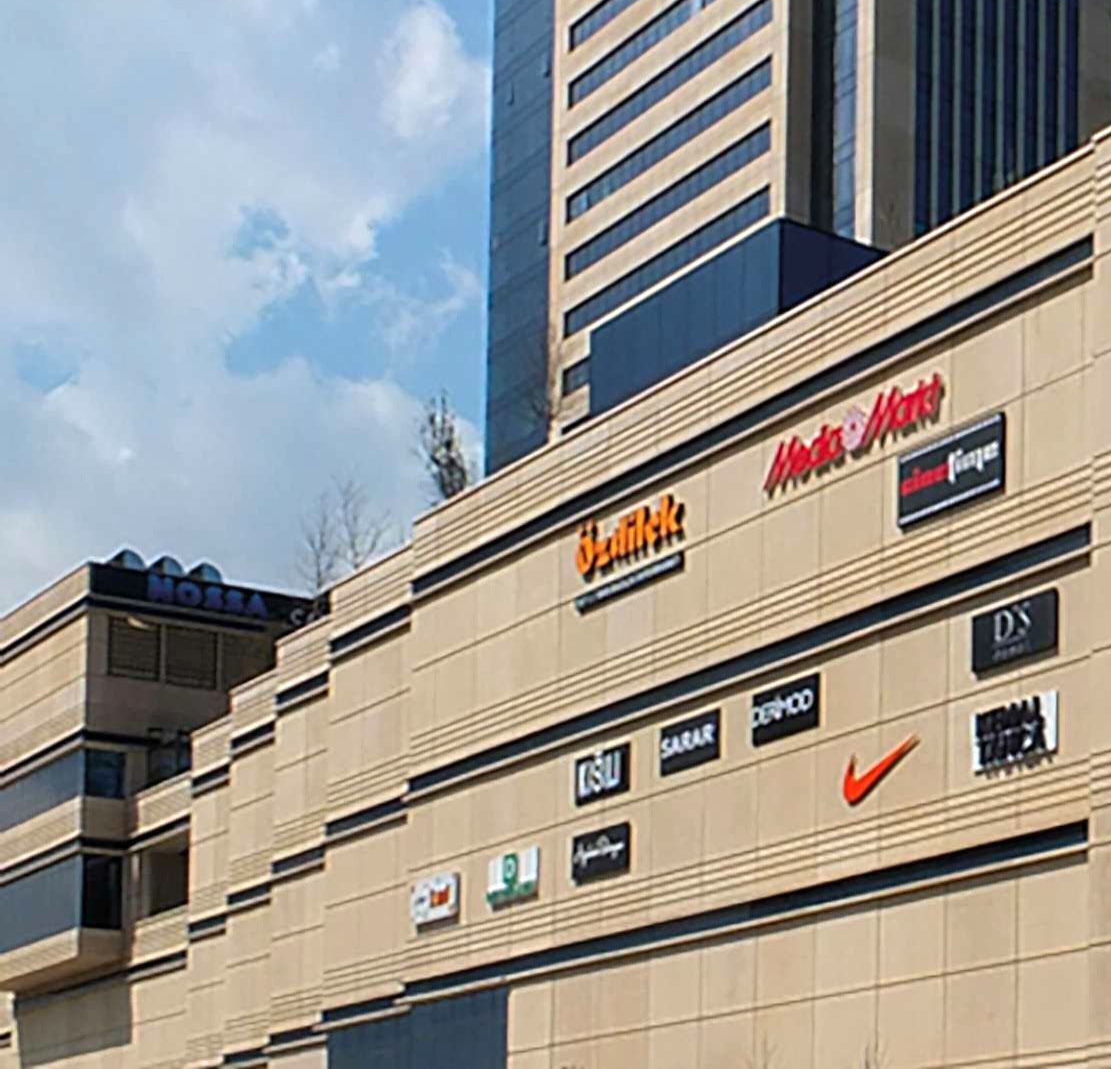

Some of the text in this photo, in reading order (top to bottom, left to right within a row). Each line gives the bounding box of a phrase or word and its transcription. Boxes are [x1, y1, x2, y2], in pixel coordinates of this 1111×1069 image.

[861, 371, 941, 447] Markt
[575, 494, 685, 575] Özdilek
[661, 722, 716, 759] SARAR
